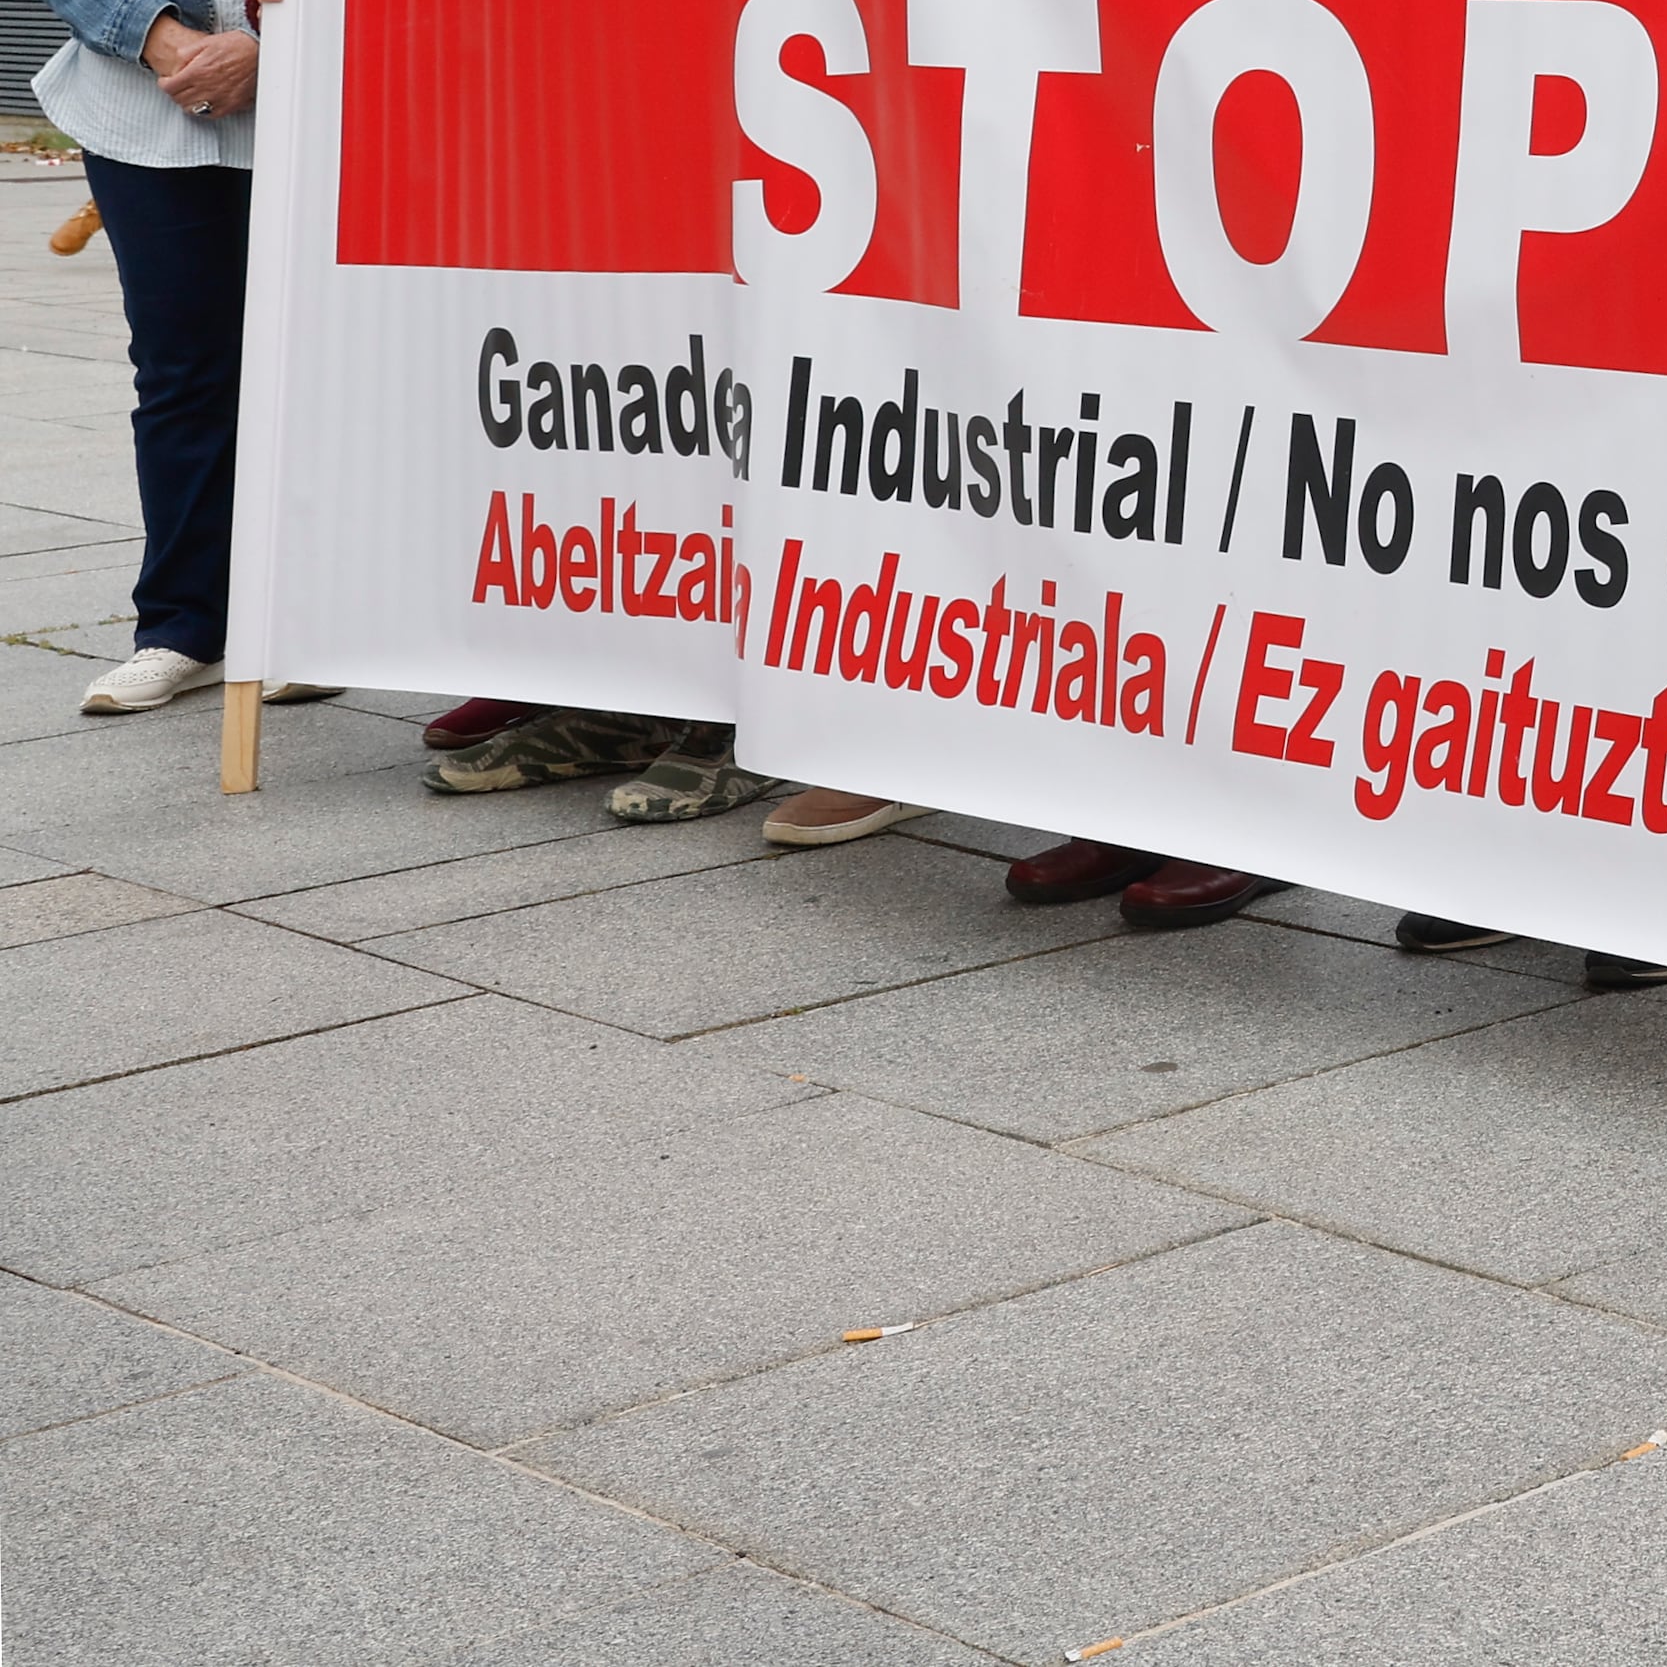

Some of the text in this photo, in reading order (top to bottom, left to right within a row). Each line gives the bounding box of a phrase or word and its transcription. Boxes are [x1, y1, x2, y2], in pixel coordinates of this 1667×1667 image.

[781, 356, 1193, 545] Industrial
[1282, 412, 1415, 575] No
[1449, 472, 1629, 609] nos
[764, 538, 1166, 737] Industriala
[1232, 611, 1345, 768] Ez
